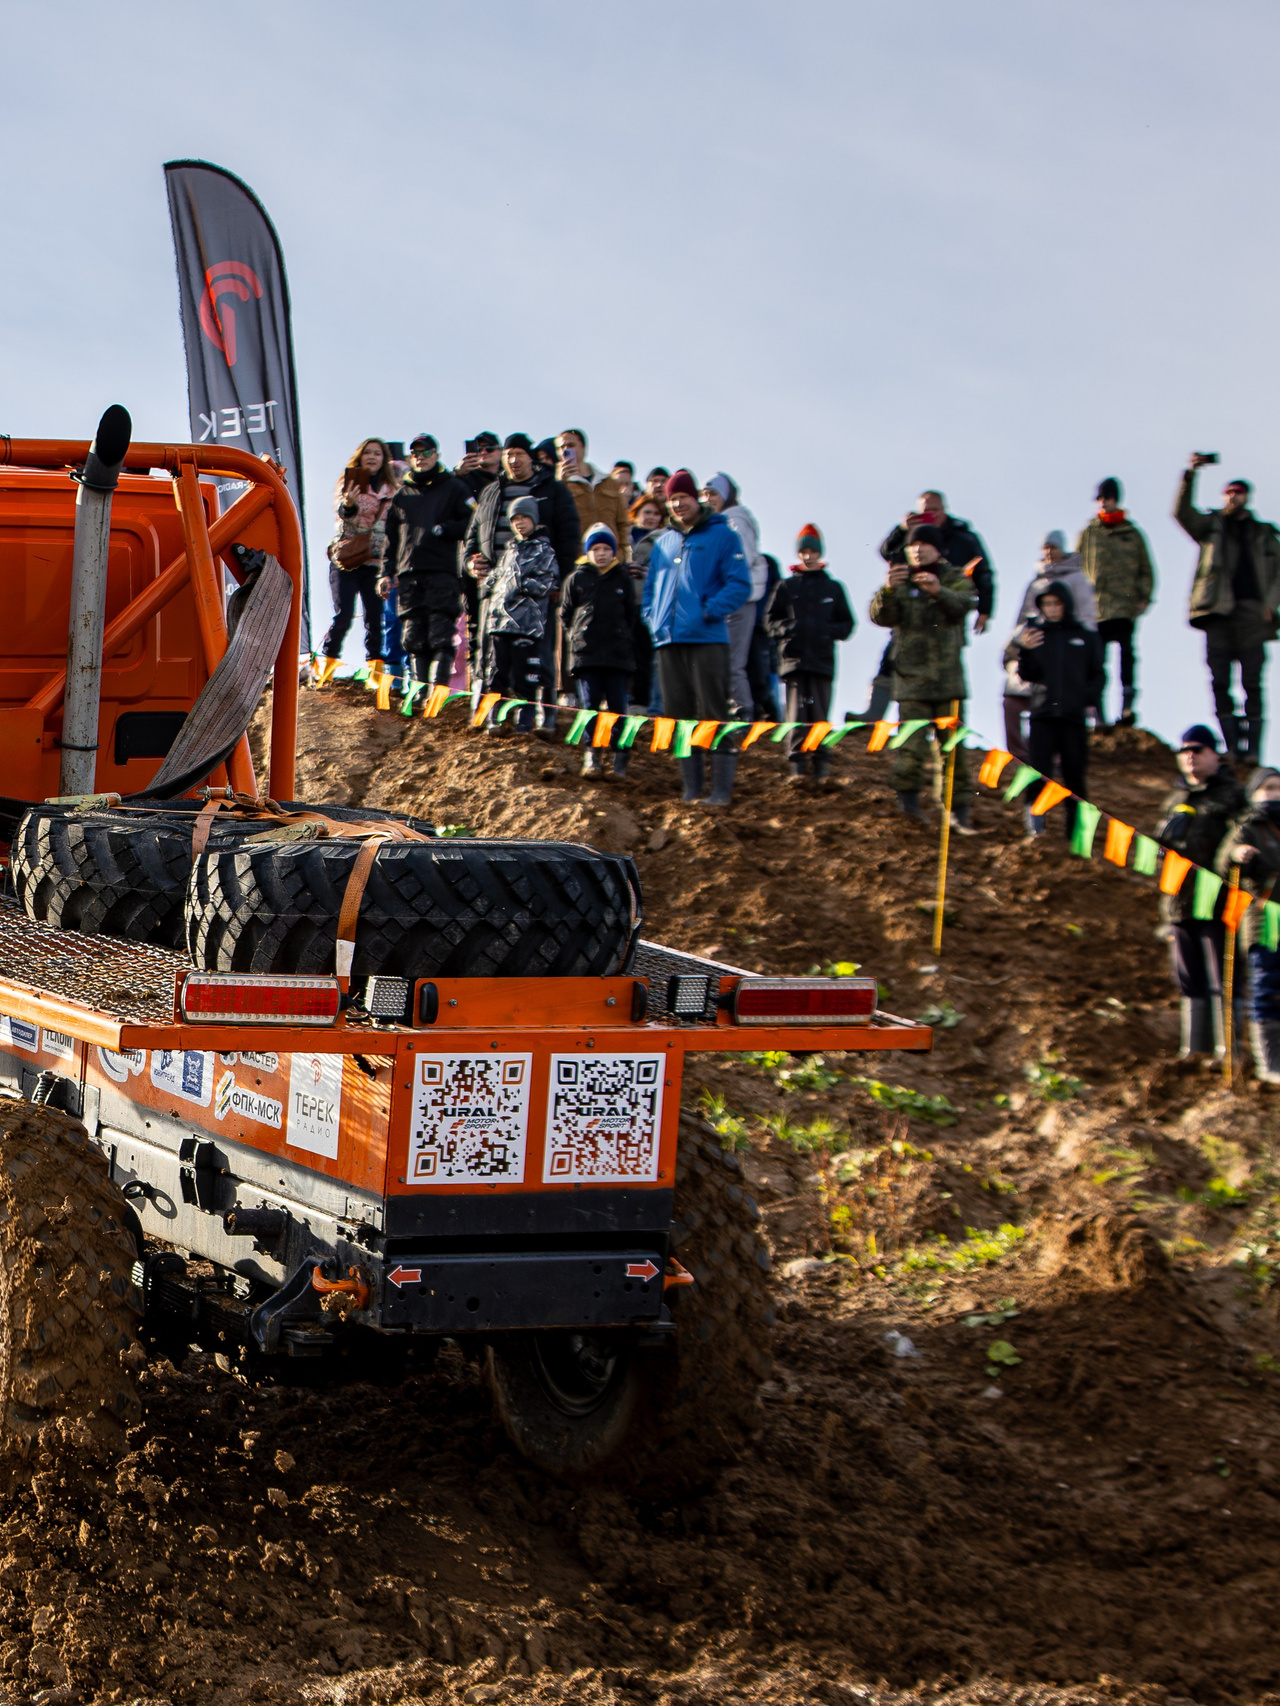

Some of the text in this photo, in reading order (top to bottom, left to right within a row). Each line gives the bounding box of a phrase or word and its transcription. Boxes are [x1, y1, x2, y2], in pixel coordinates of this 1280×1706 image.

[232, 1092, 281, 1124] ФПК-МСК
[295, 1092, 335, 1125] ТЕРЕК
[443, 1107, 497, 1117] URAL
[578, 1107, 631, 1117] URAL
[296, 1119, 332, 1139] РАДИО
